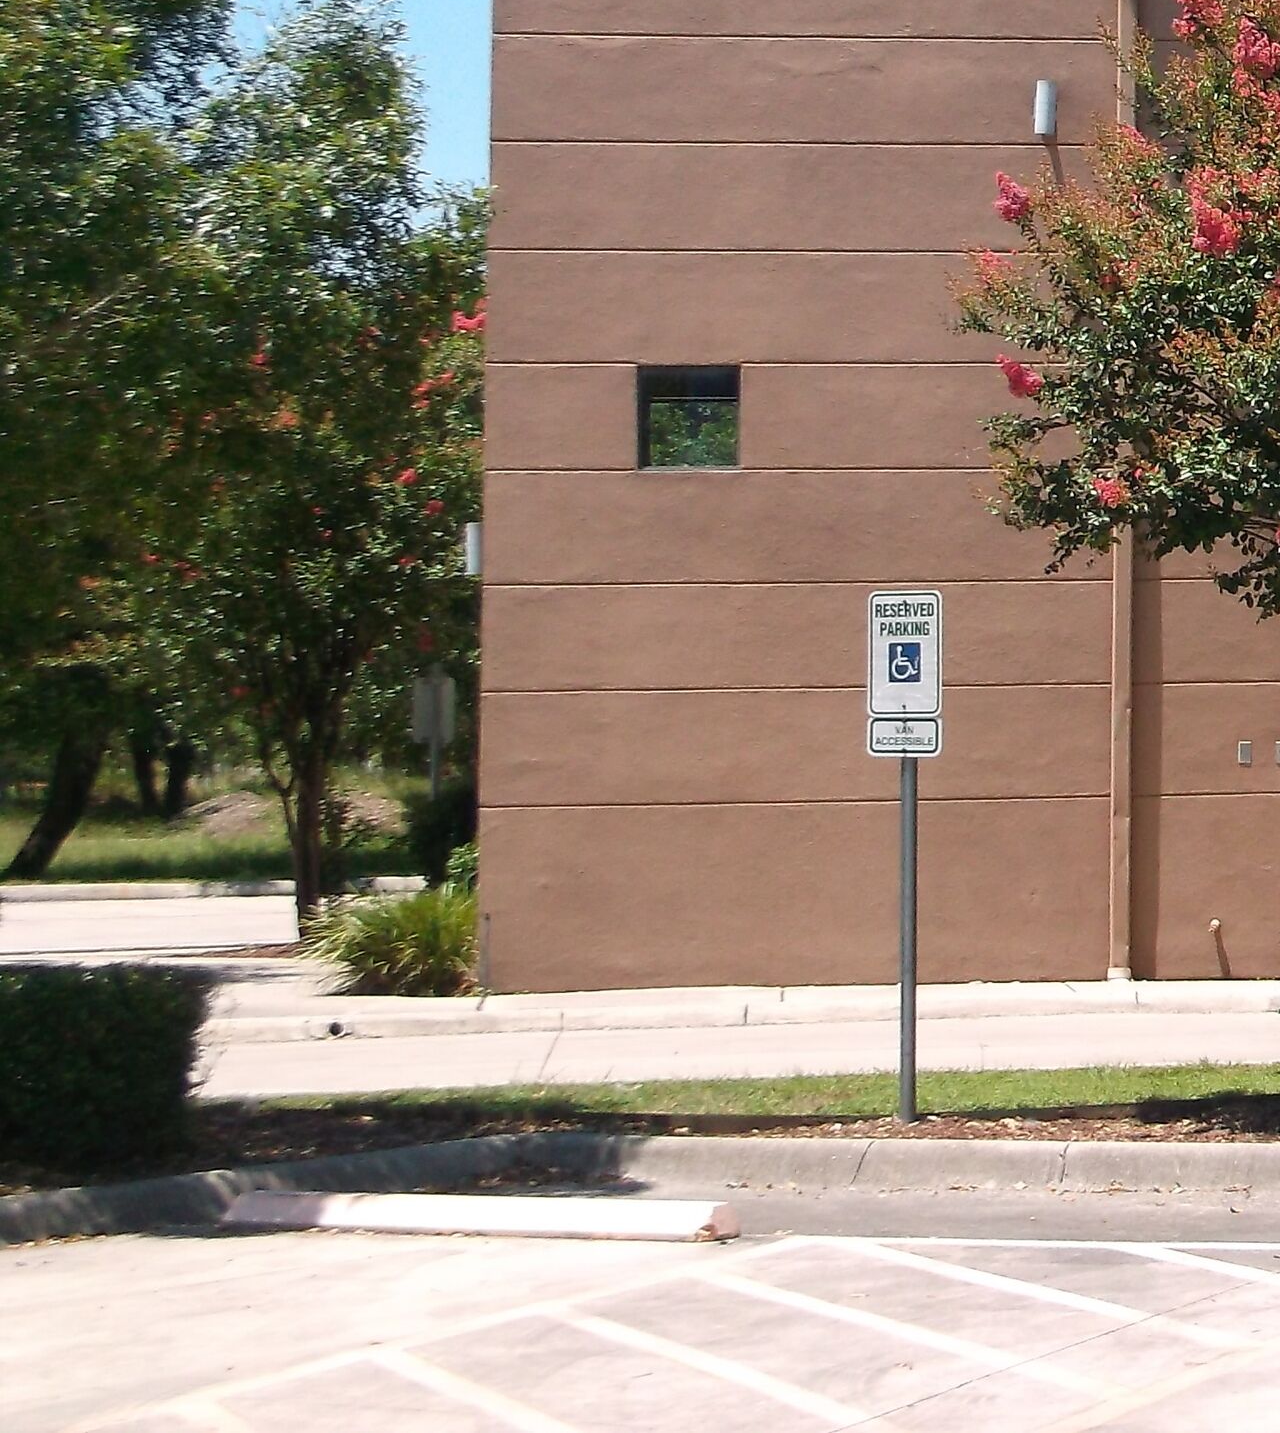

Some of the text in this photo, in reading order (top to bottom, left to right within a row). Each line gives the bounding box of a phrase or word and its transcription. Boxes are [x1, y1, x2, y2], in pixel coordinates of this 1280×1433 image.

[875, 602, 935, 618] RESERVED
[880, 621, 930, 637] PARKING
[895, 726, 914, 735] VAN
[875, 736, 934, 746] ACCESSIBLE
